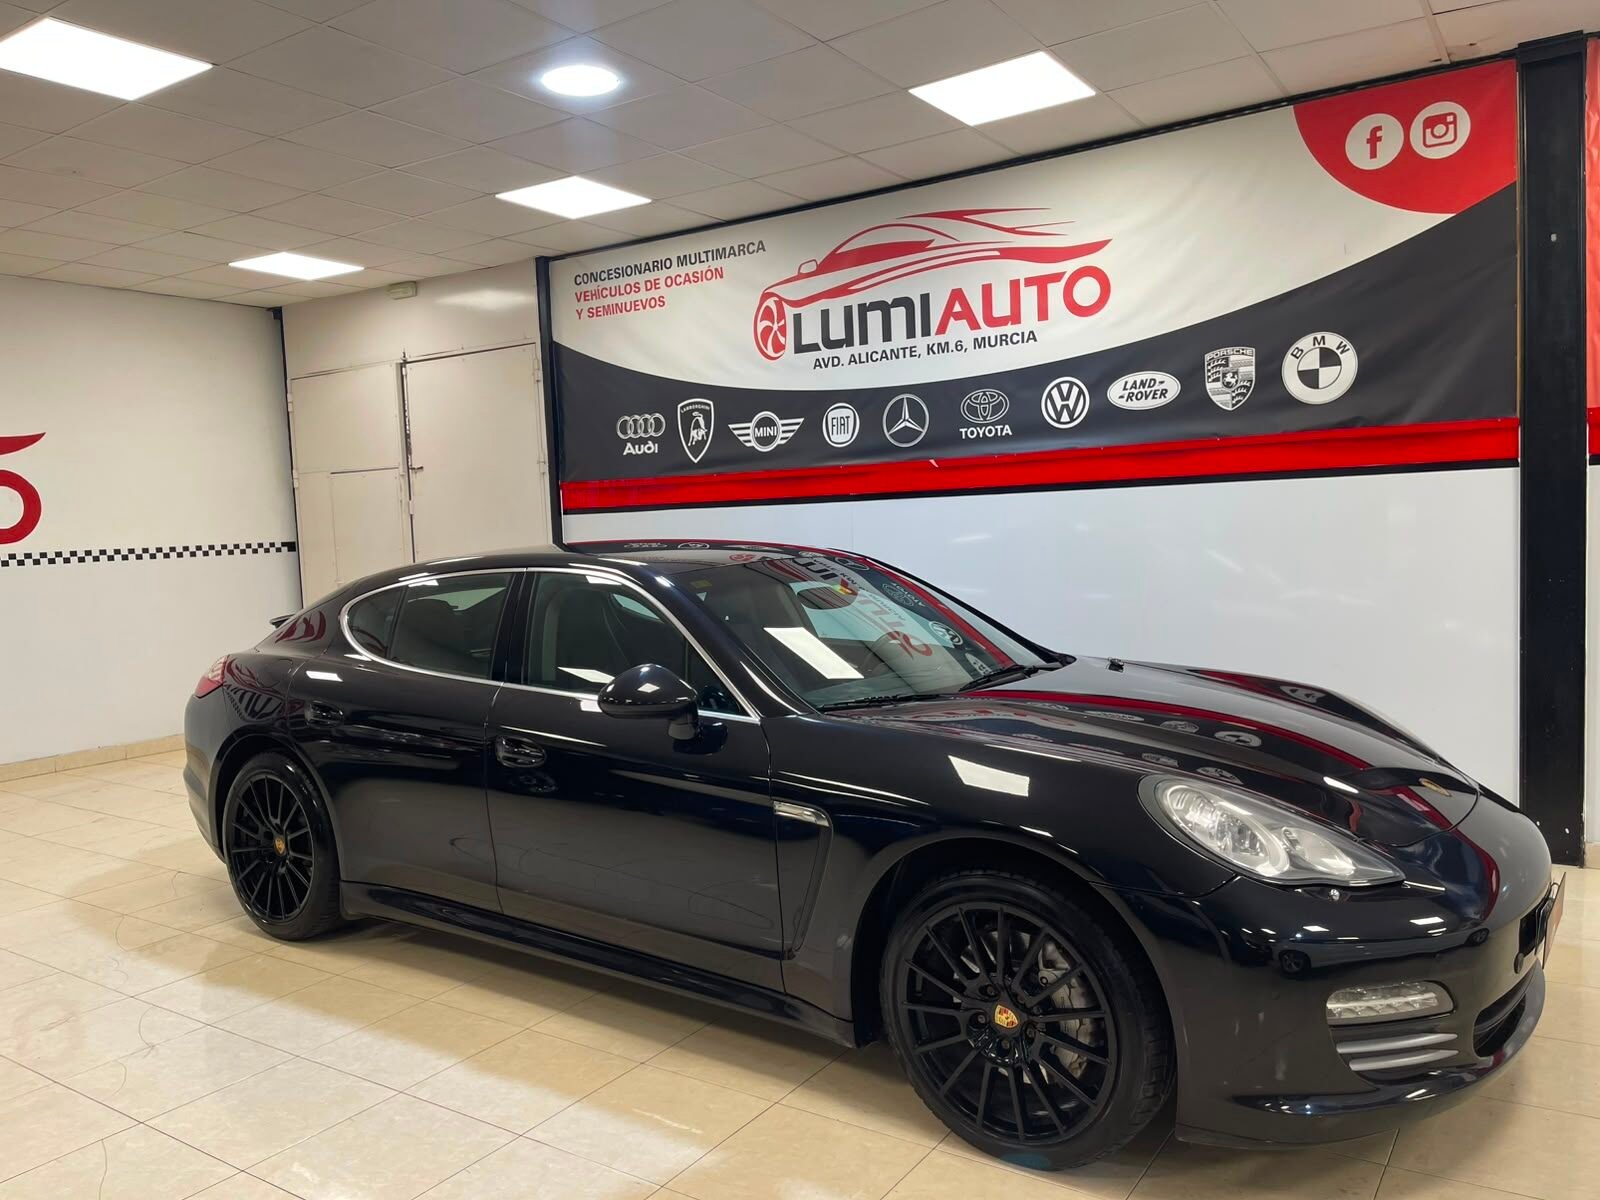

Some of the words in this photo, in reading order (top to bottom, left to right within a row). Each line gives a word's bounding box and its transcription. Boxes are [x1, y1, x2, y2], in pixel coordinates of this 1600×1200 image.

[574, 257, 673, 287] CONCESIONARIO
[676, 239, 767, 268] MULTIMARCA
[574, 281, 641, 304] VEHÍCULOS
[644, 277, 662, 293] DE
[664, 265, 725, 289] OCASIÓN
[575, 308, 584, 321] Y
[587, 295, 667, 319] SEMINUEVOS
[812, 355, 845, 370] AVD.
[847, 346, 922, 367] ALICANTE,
[972, 330, 1038, 351] MURCIA
[1206, 347, 1254, 361] PORSCHE
[1290, 335, 1351, 360] BMW
[754, 424, 777, 438] MINI
[831, 415, 851, 437] FIAT
[960, 424, 1013, 440] TOYOTA
[623, 441, 659, 456] Audi
